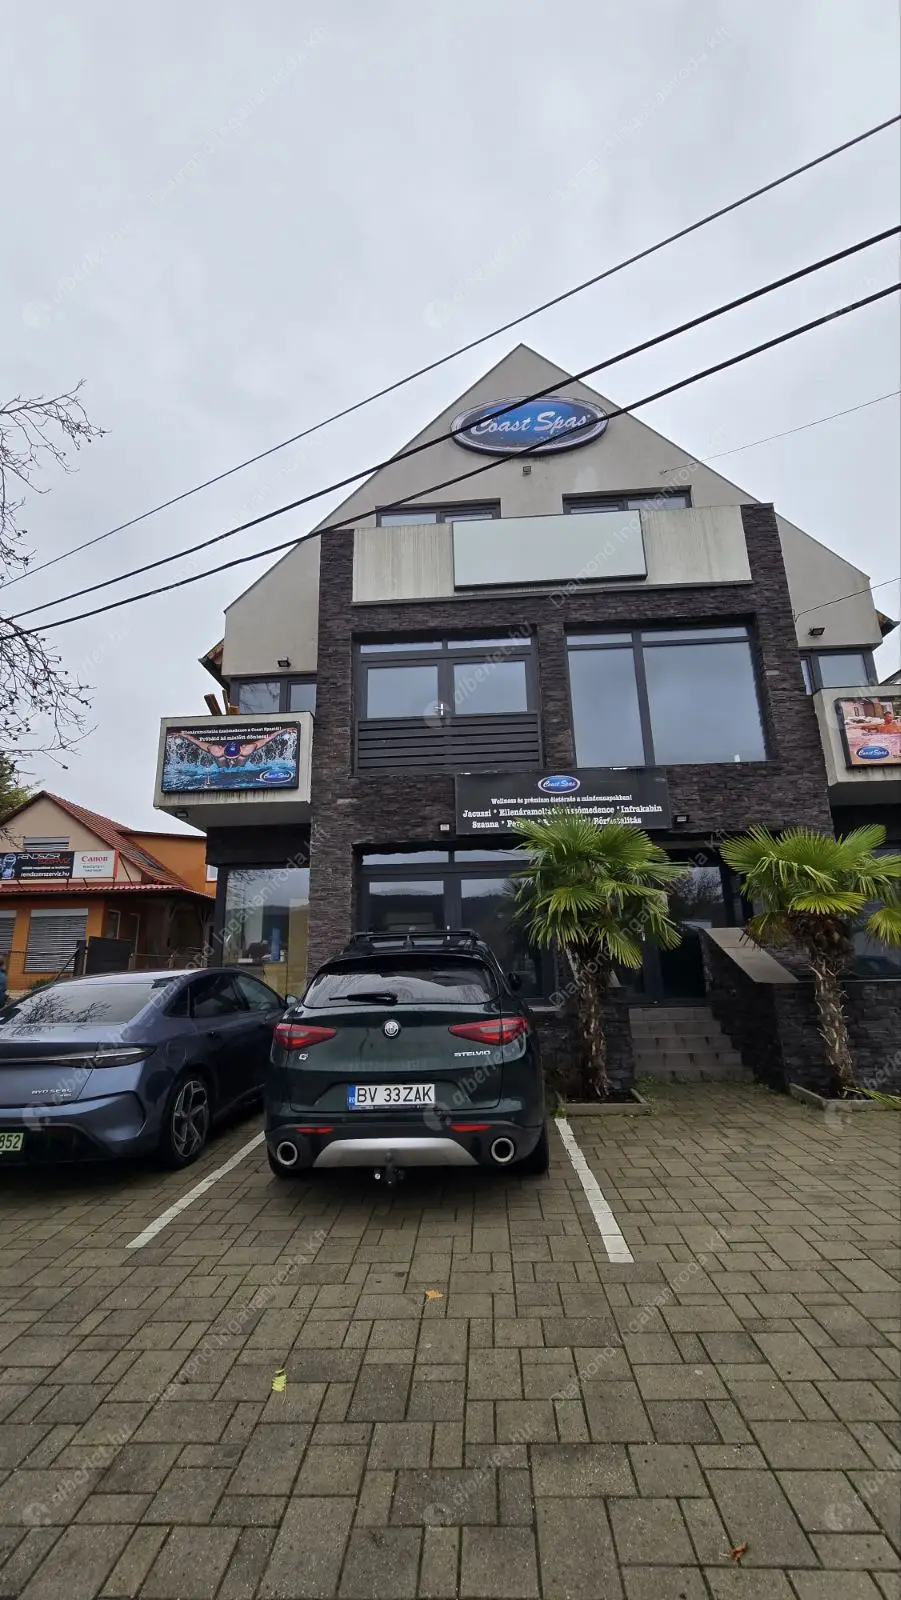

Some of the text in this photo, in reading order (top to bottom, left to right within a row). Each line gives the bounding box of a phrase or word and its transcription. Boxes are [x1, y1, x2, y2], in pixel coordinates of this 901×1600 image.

[470, 411, 587, 435] Coast Spas
[543, 779, 577, 788] Coast Spas
[621, 804, 662, 812] Infrakabin
[357, 1087, 377, 1103] BV
